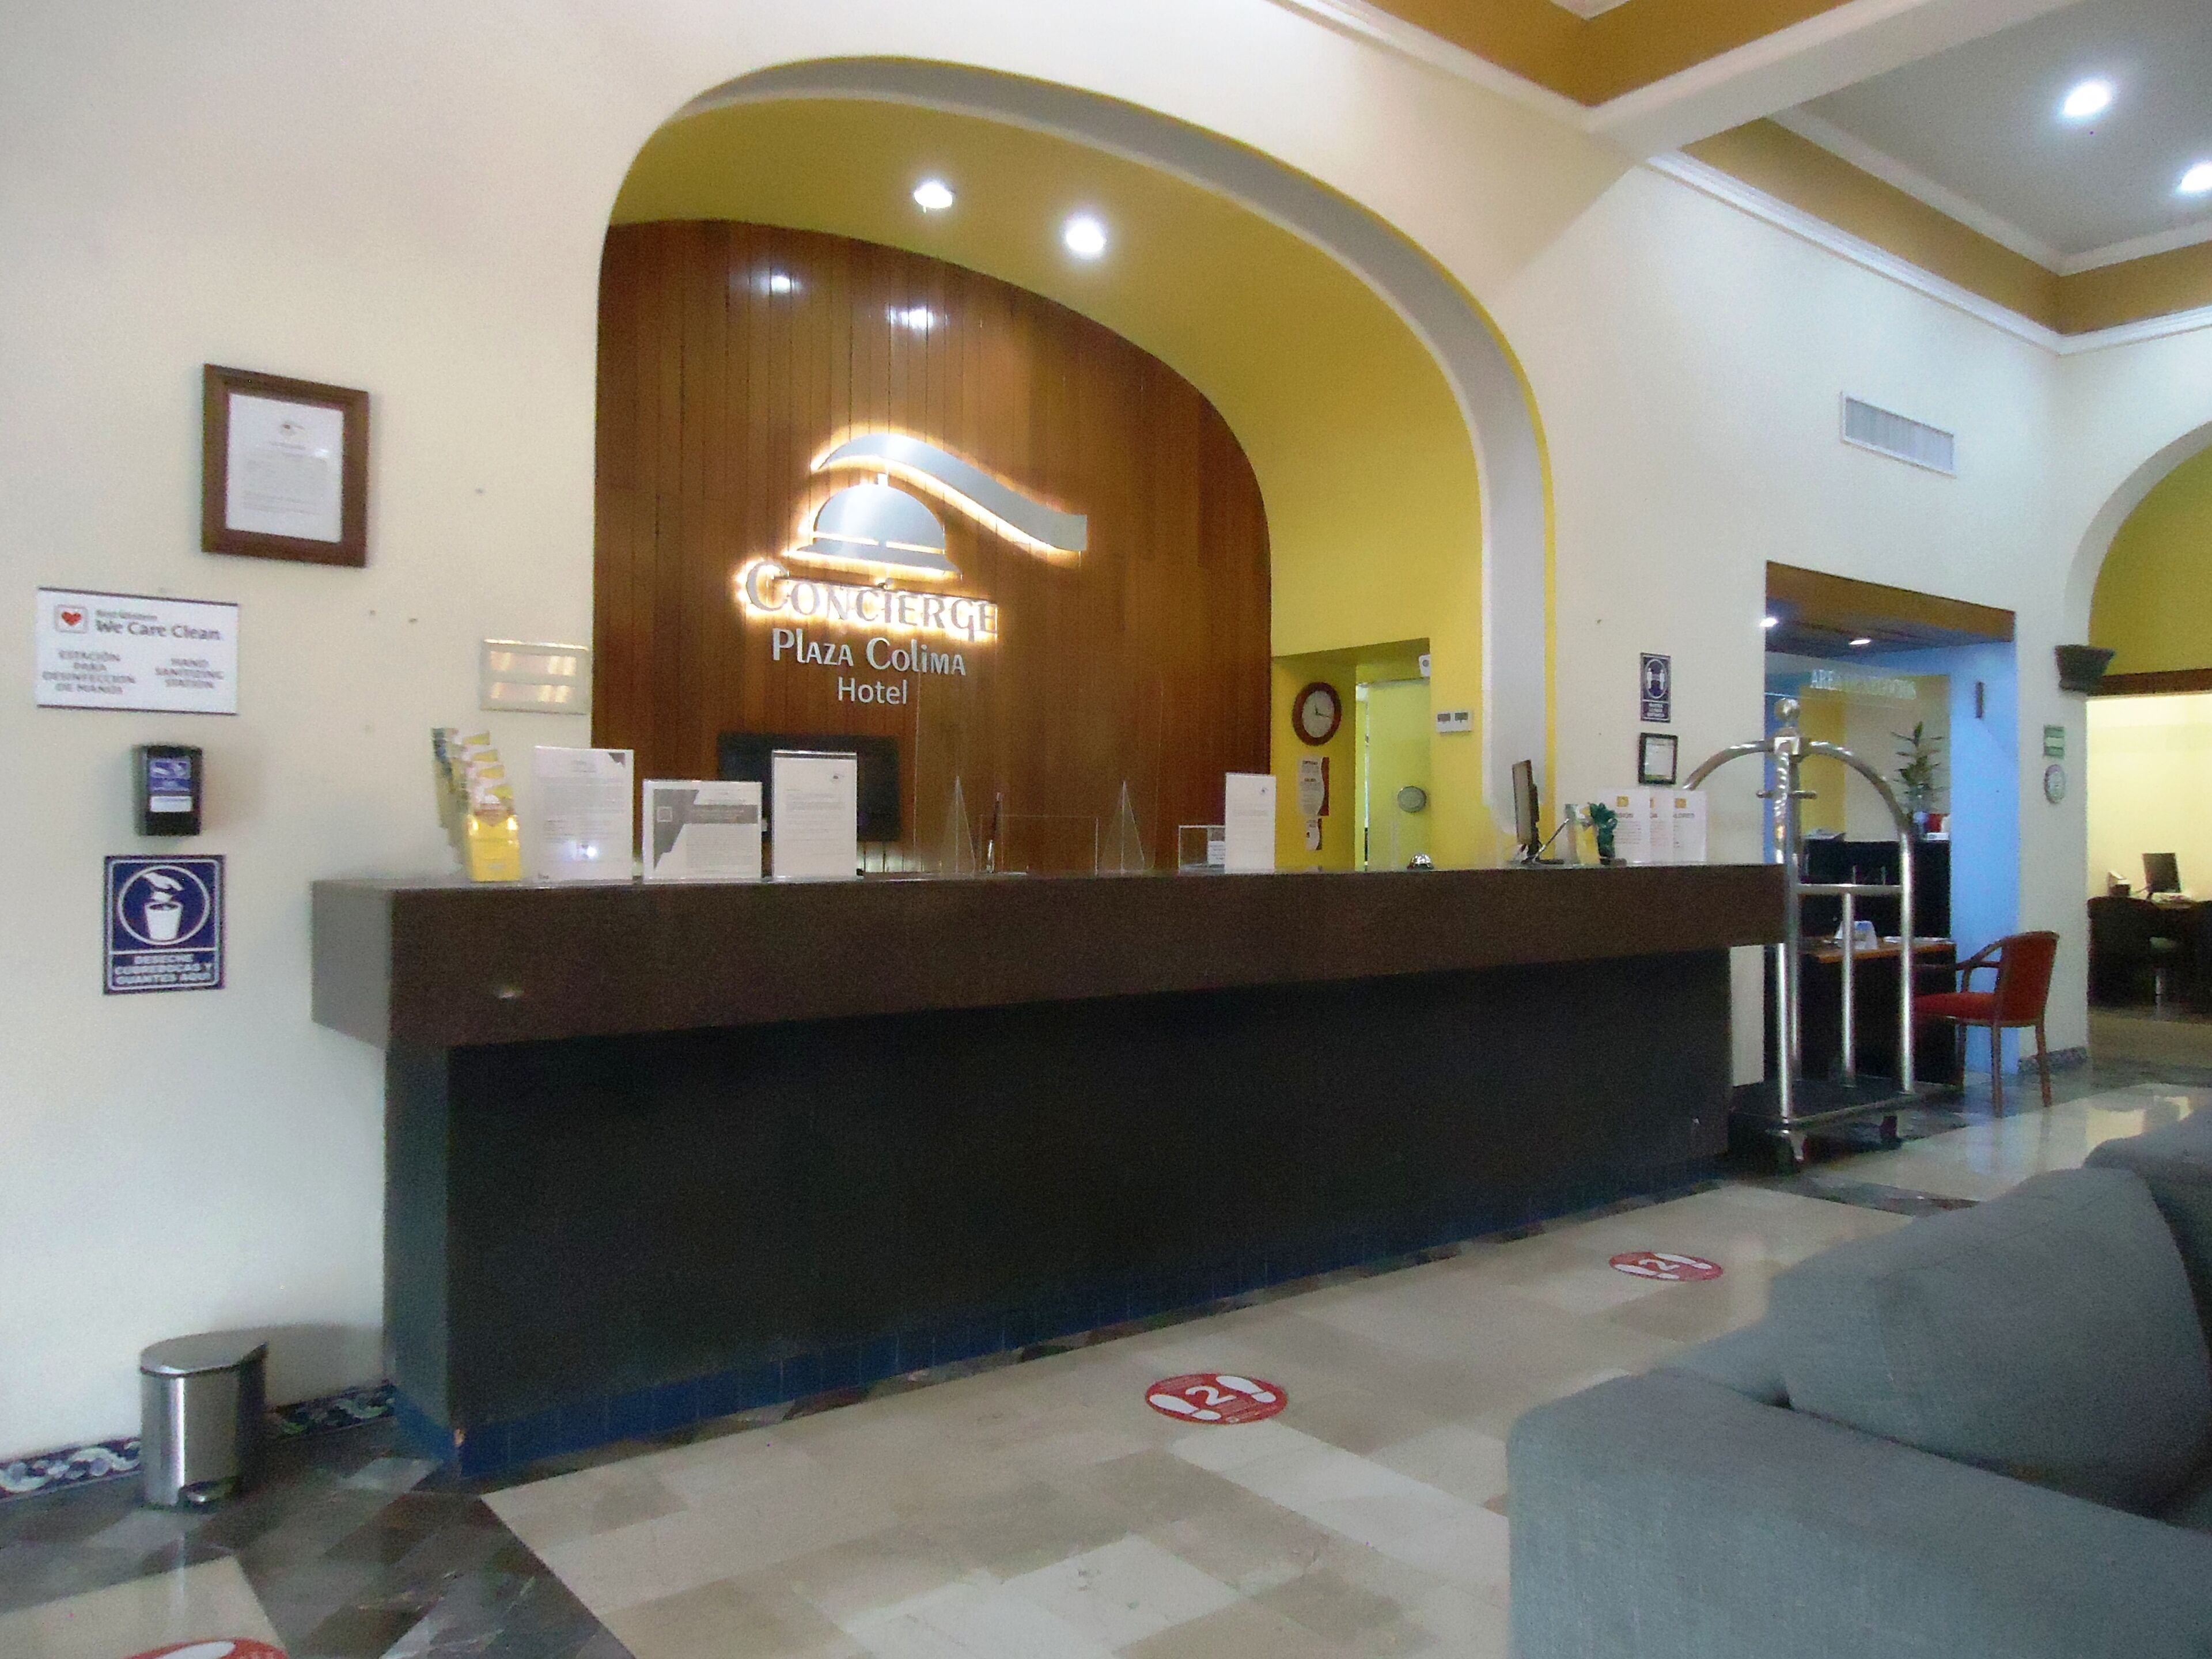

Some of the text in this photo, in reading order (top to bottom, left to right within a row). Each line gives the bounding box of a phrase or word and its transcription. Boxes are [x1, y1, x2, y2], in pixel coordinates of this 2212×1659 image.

[96, 620, 222, 641] We Care Clean
[838, 676, 908, 705] Hotel
[1638, 1258, 1680, 1271] 2
[1185, 1385, 1237, 1406] 2
